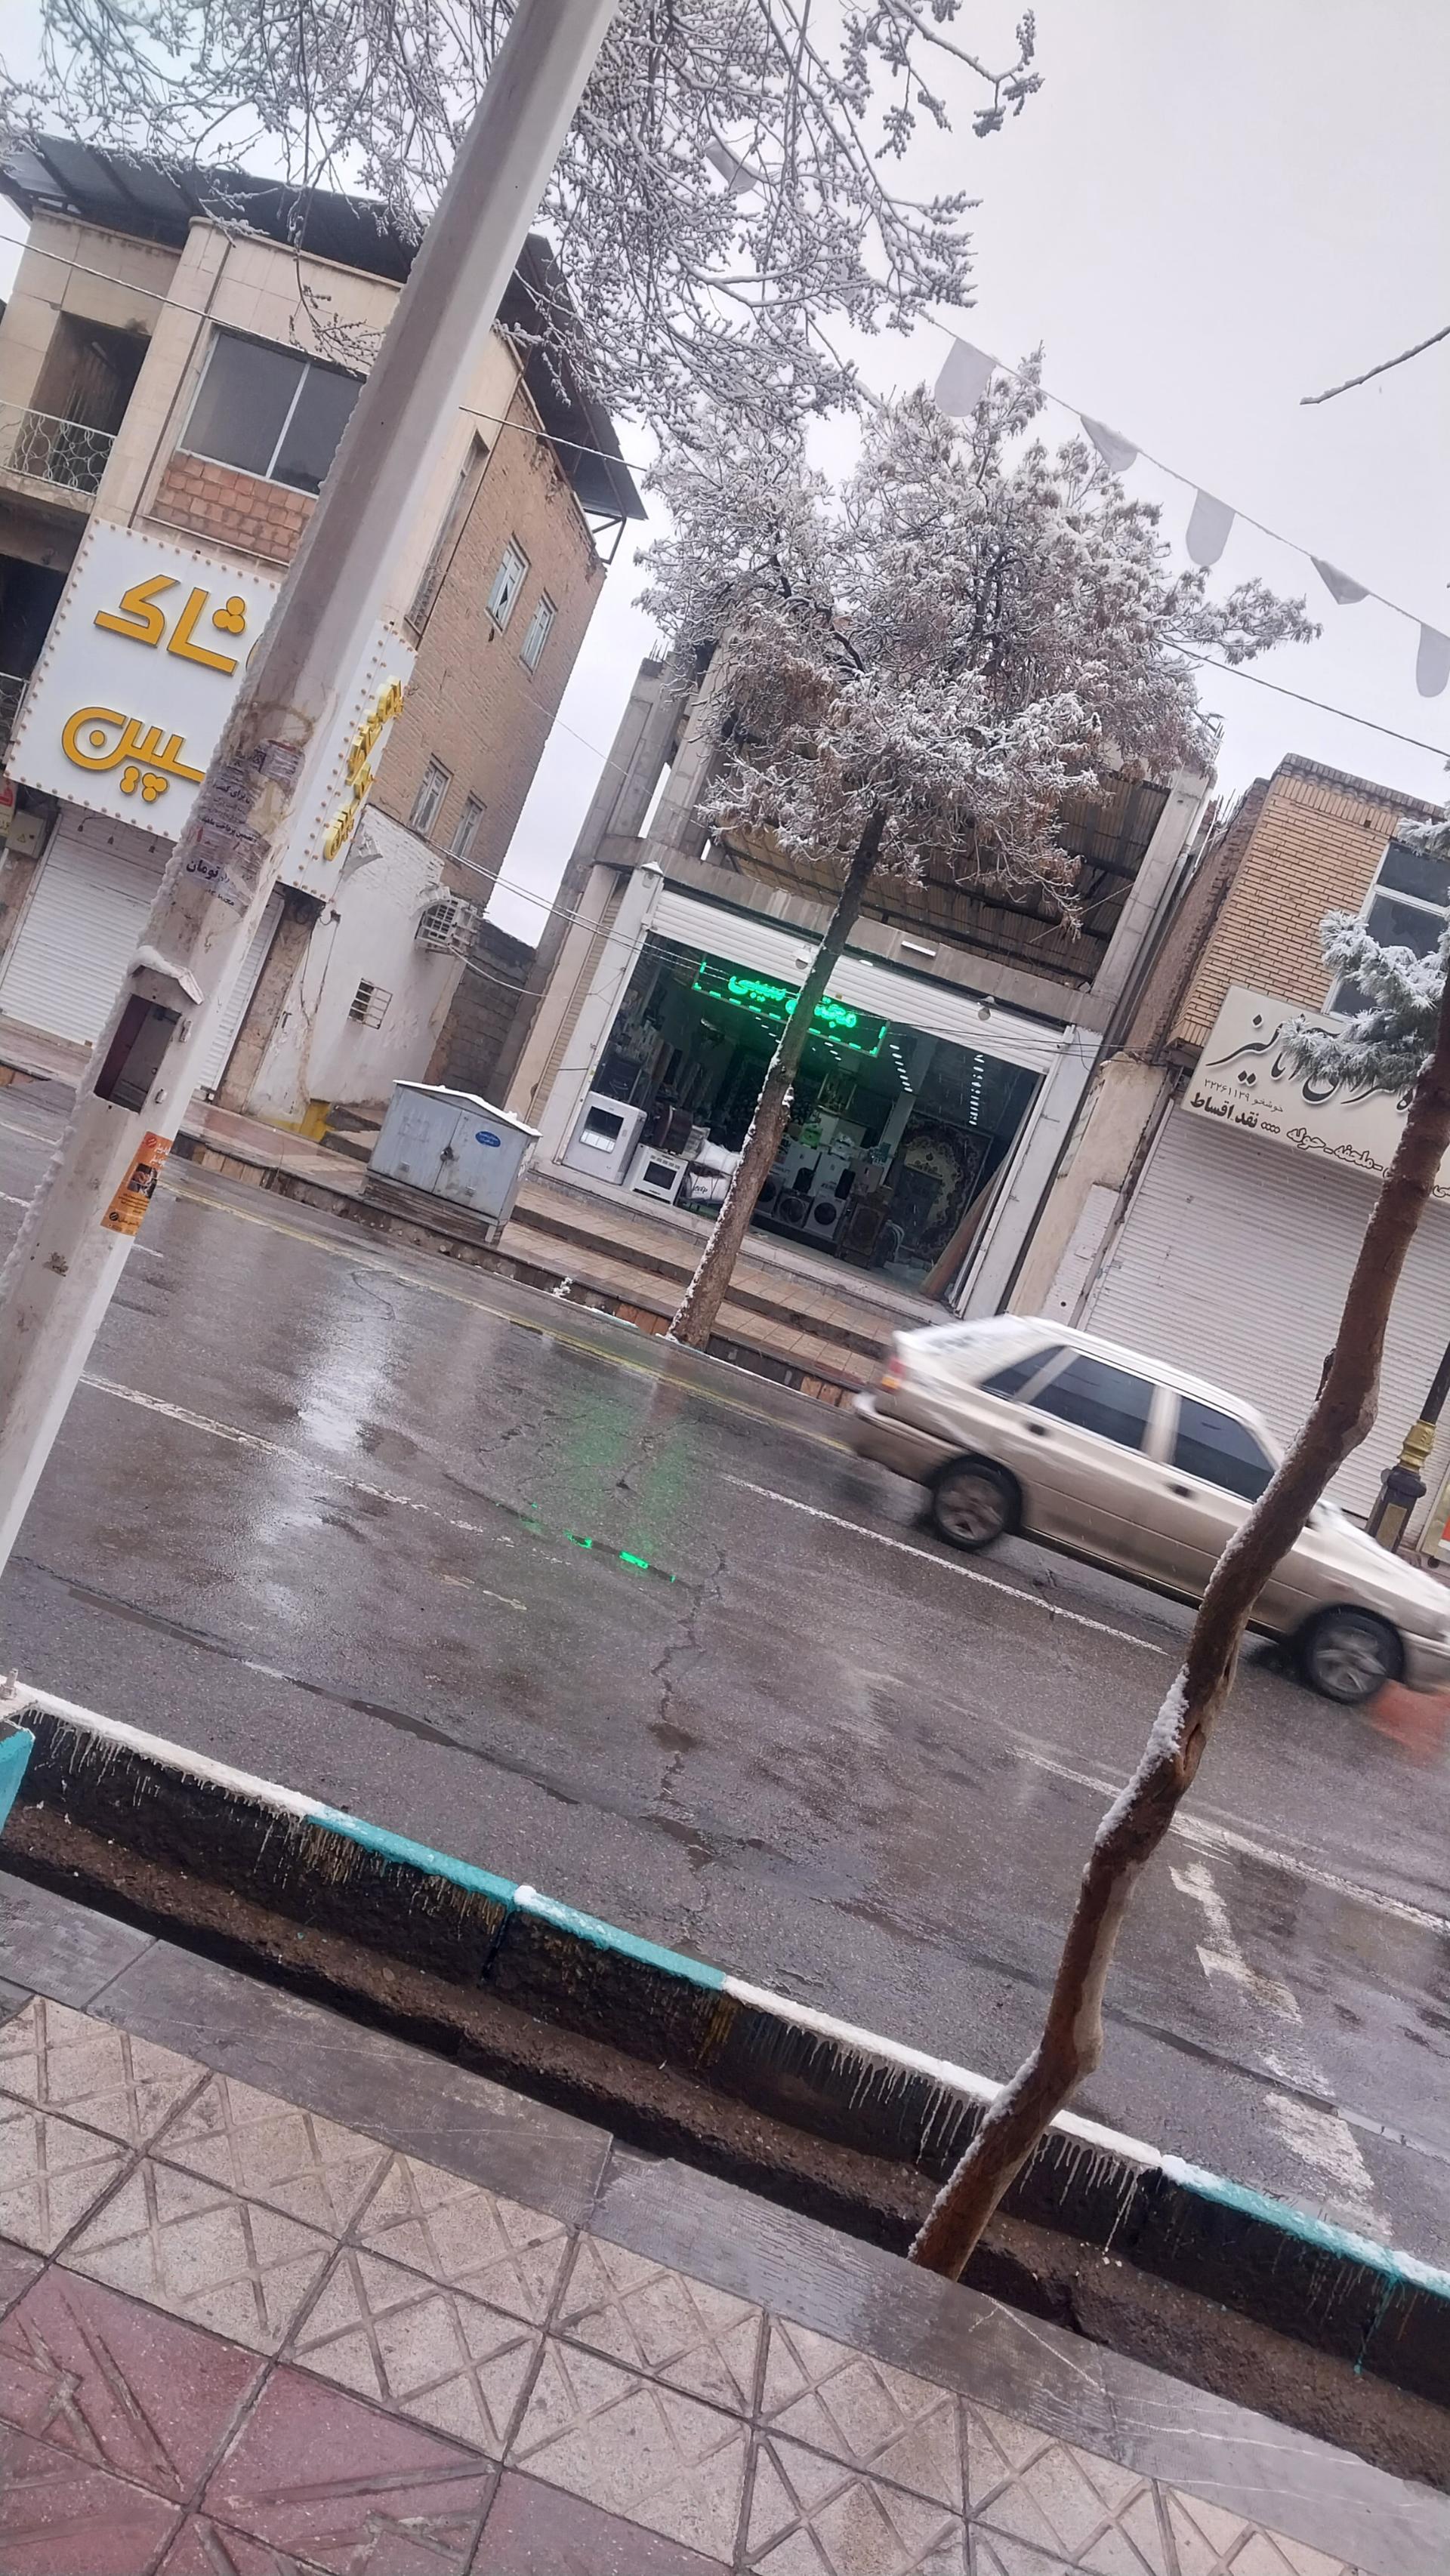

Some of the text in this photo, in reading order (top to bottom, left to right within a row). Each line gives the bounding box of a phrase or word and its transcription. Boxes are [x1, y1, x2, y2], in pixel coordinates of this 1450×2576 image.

[93, 574, 261, 675] شاک
[186, 860, 221, 880] تومان
[1190, 1092, 1236, 1119] اقساط
